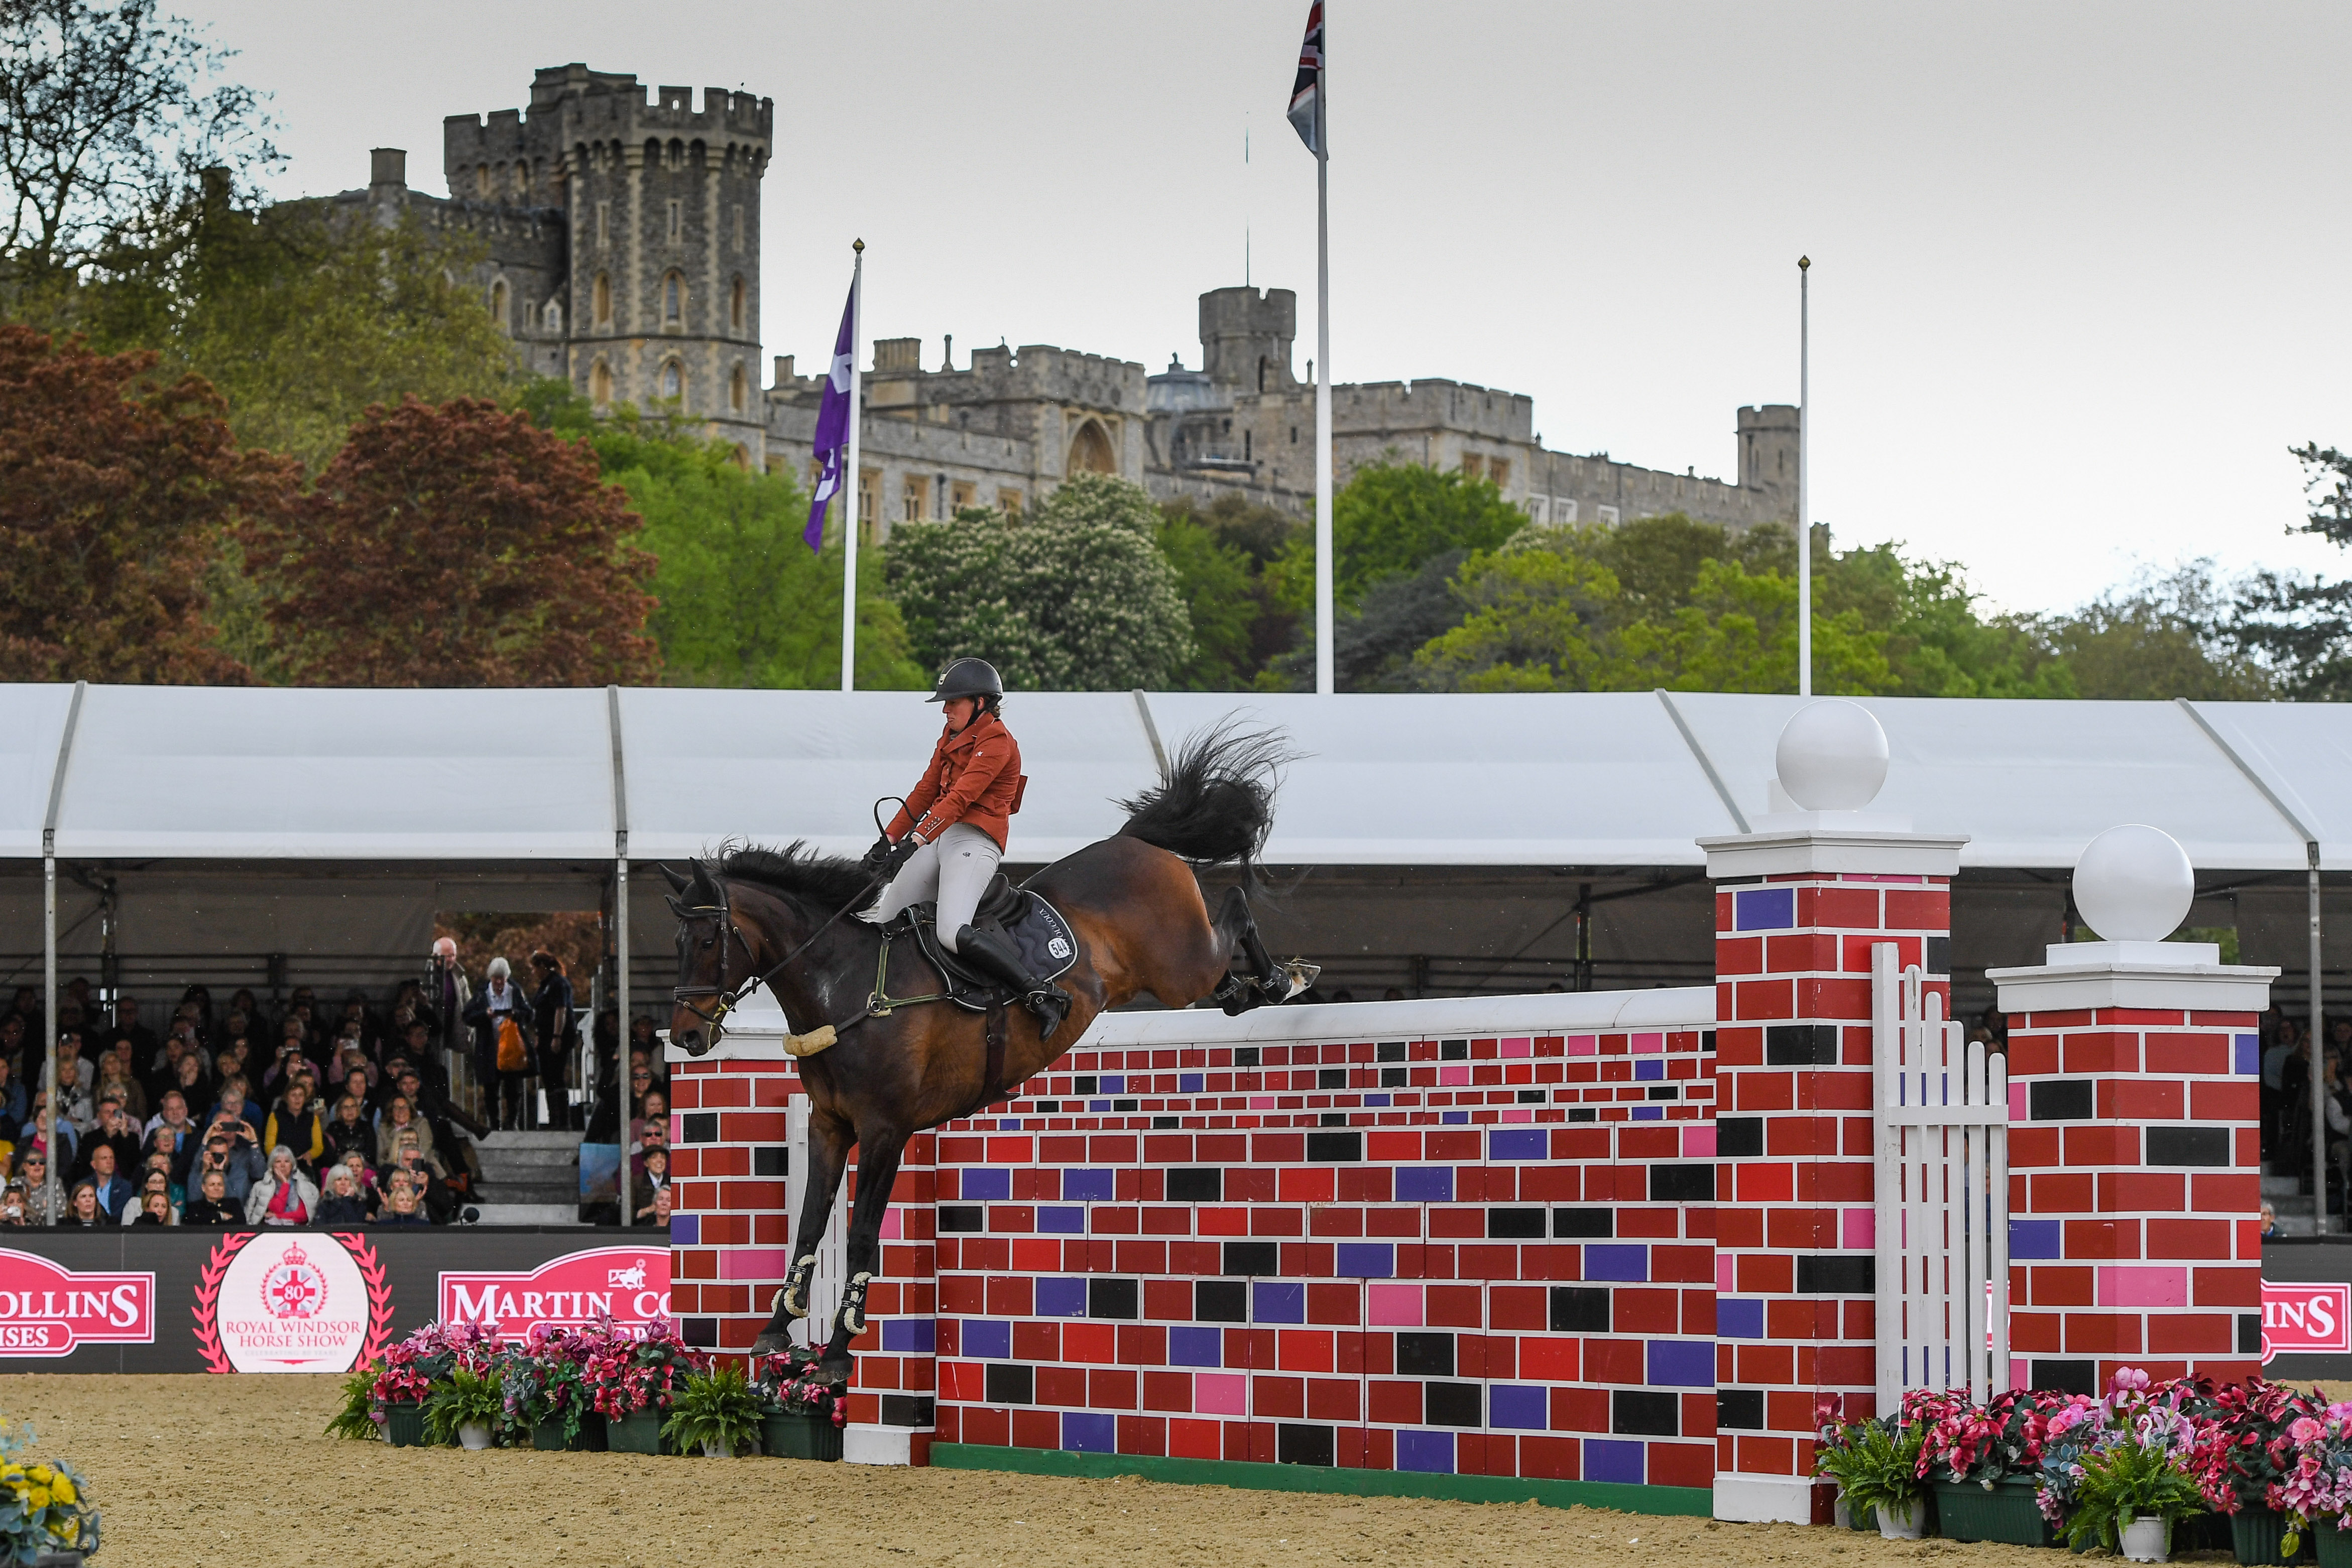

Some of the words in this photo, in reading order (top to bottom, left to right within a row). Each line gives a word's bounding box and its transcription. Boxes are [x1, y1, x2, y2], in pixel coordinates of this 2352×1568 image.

[1051, 940, 1068, 955] 544
[284, 1285, 303, 1300] 80
[0, 1284, 139, 1327] OLLINS
[450, 1284, 613, 1326] MARTIN
[226, 1321, 275, 1334] ROYAL
[281, 1321, 361, 1334] WINDSOR
[240, 1336, 292, 1347] HORSE
[298, 1336, 347, 1347] SHOW
